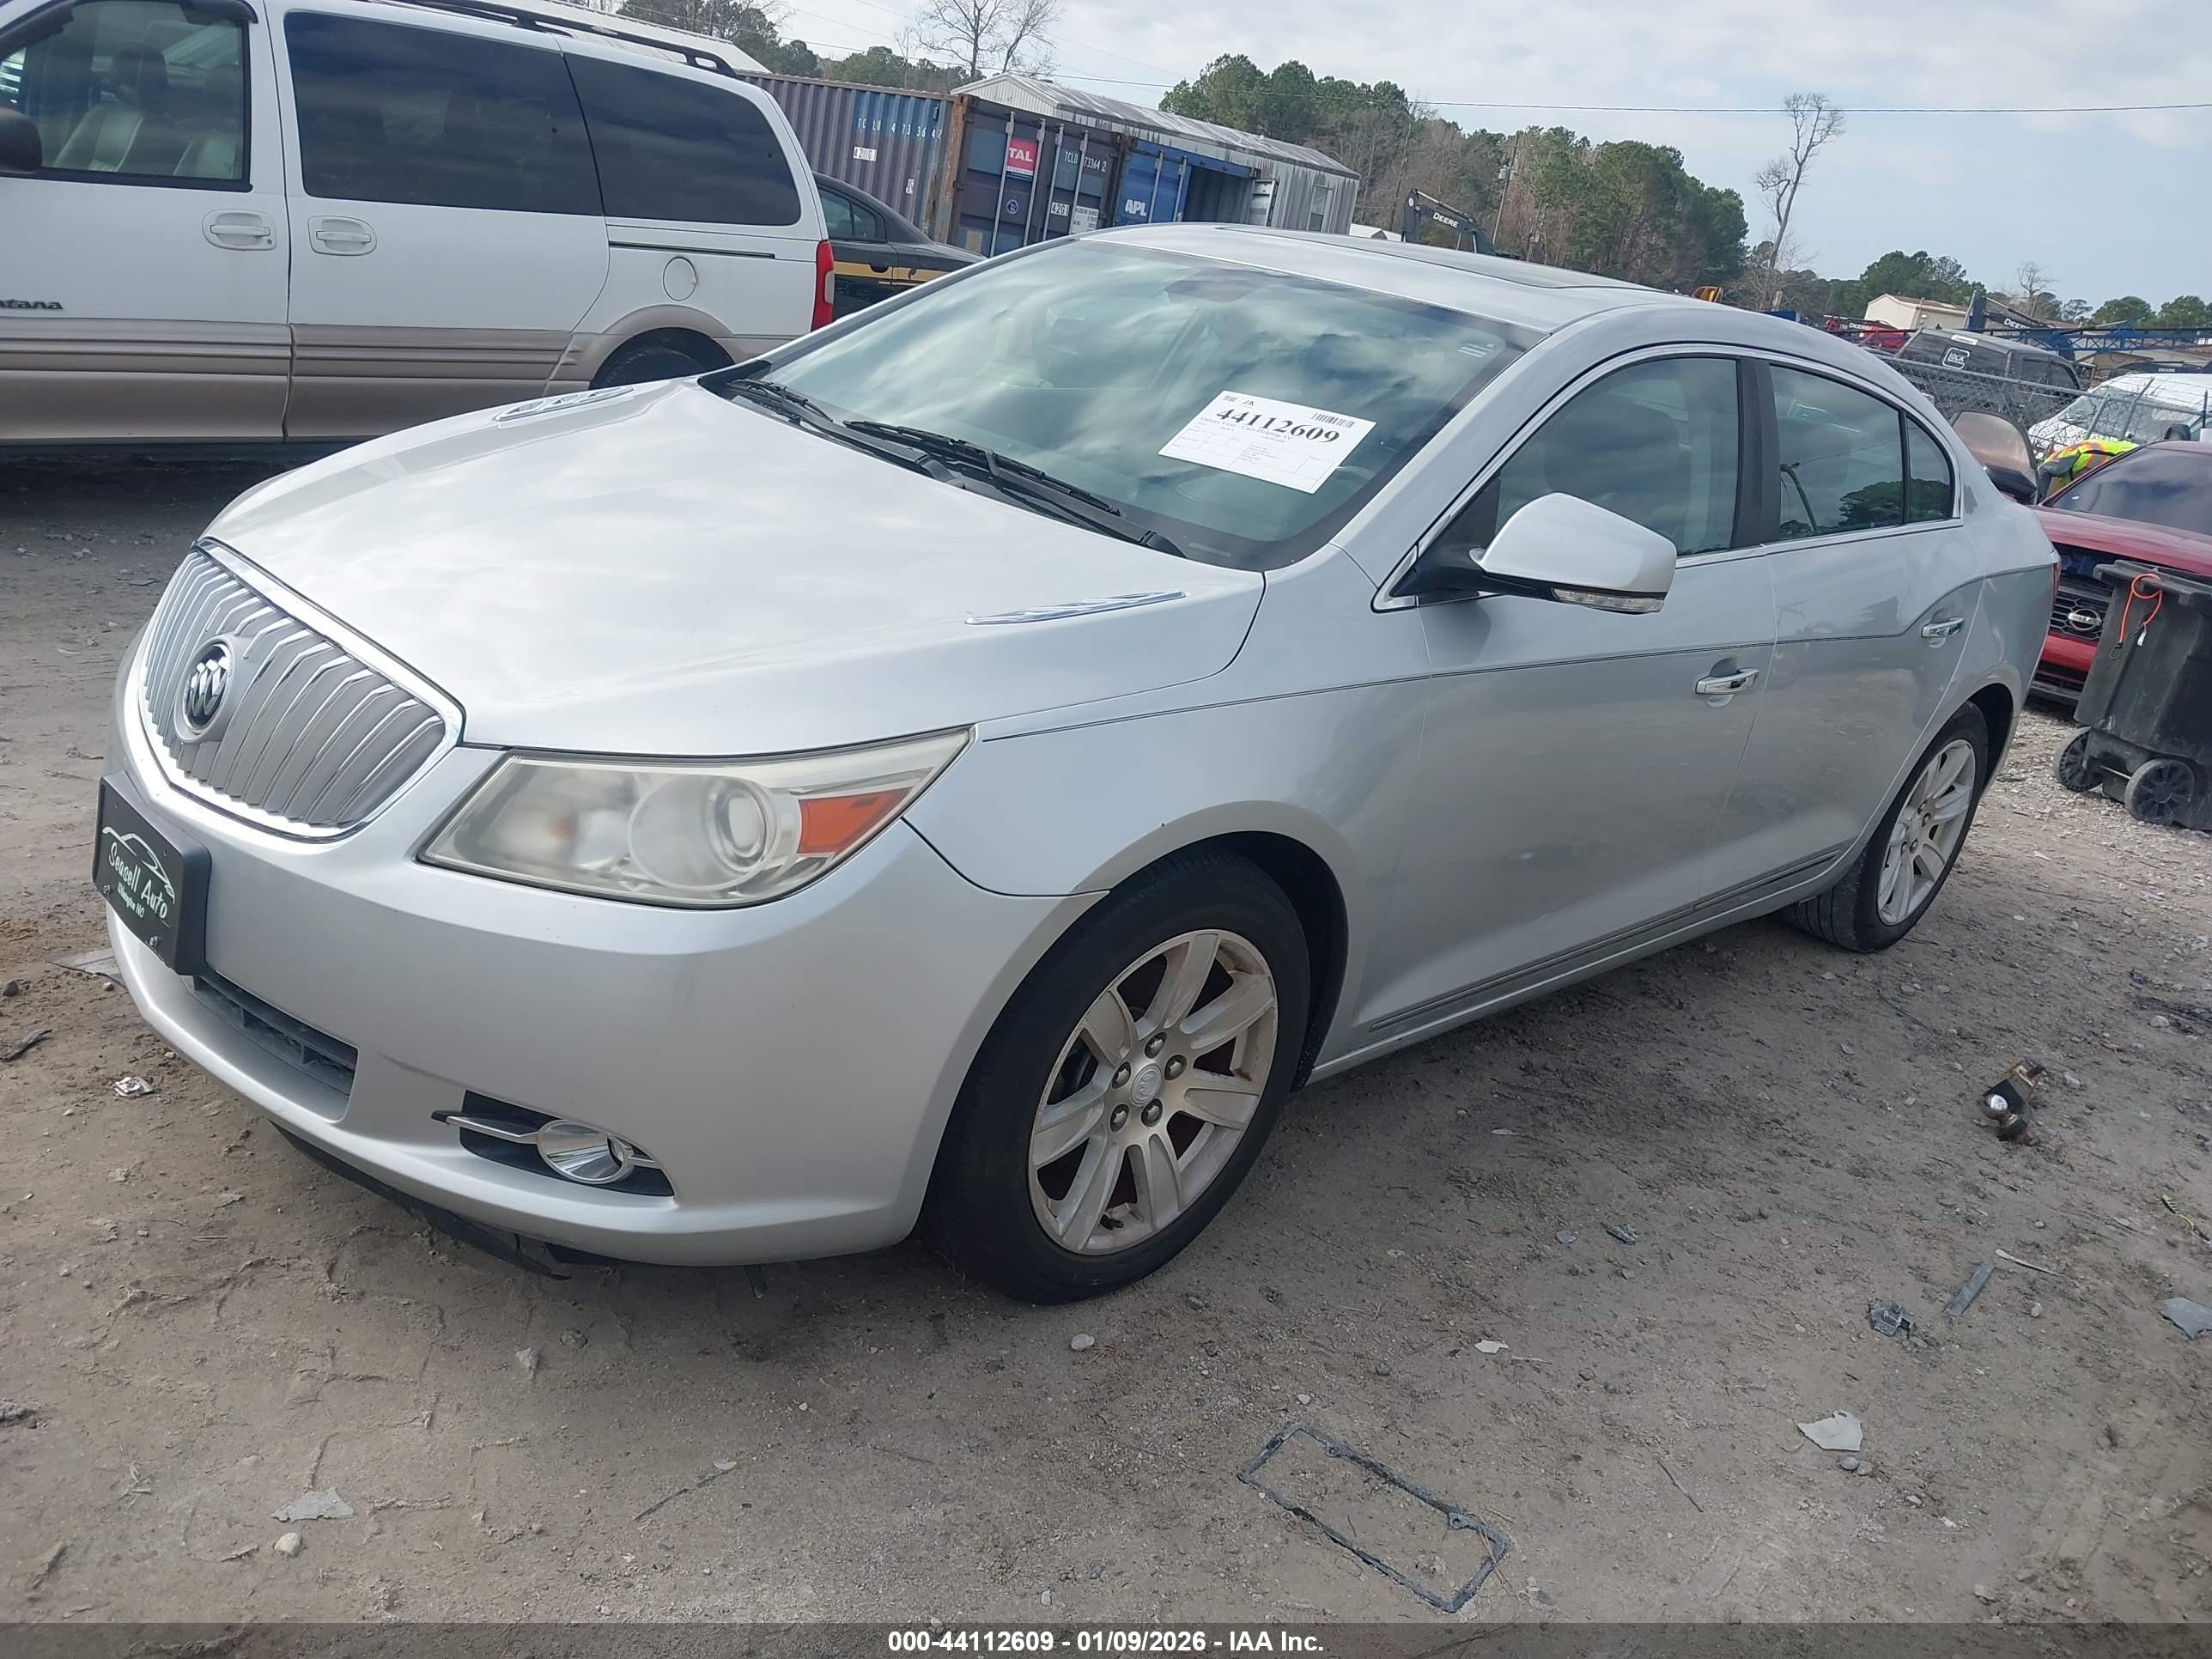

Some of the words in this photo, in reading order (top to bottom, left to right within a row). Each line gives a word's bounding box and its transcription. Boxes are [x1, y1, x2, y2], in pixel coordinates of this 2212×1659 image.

[1009, 147, 1033, 162] TAL
[1065, 151, 1079, 164] TCLU
[1125, 199, 1146, 216] APL
[1433, 212, 1459, 228] DEERE
[2004, 318, 2031, 330] DEER
[1216, 409, 1340, 443] 44112609
[108, 842, 141, 893] Seasell
[141, 879, 167, 919] Auto
